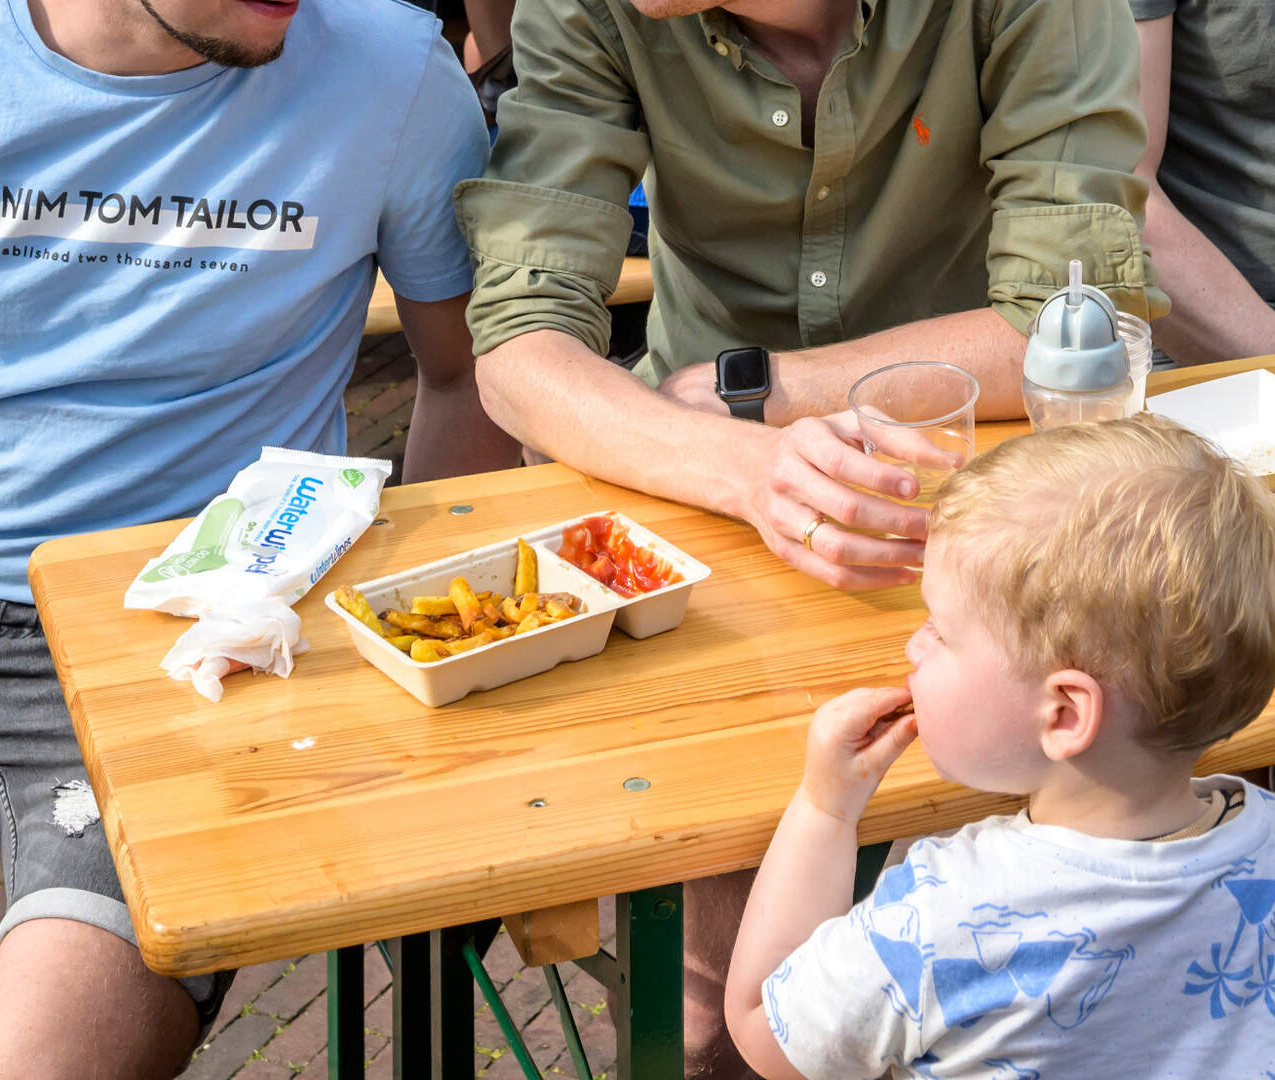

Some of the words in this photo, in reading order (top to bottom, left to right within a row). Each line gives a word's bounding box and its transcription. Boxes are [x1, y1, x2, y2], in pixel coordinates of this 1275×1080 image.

[79, 190, 162, 225] TOM
[170, 196, 304, 232] TAILOR
[78, 252, 108, 263] two
[116, 252, 193, 270] thousand
[200, 260, 249, 272] seven
